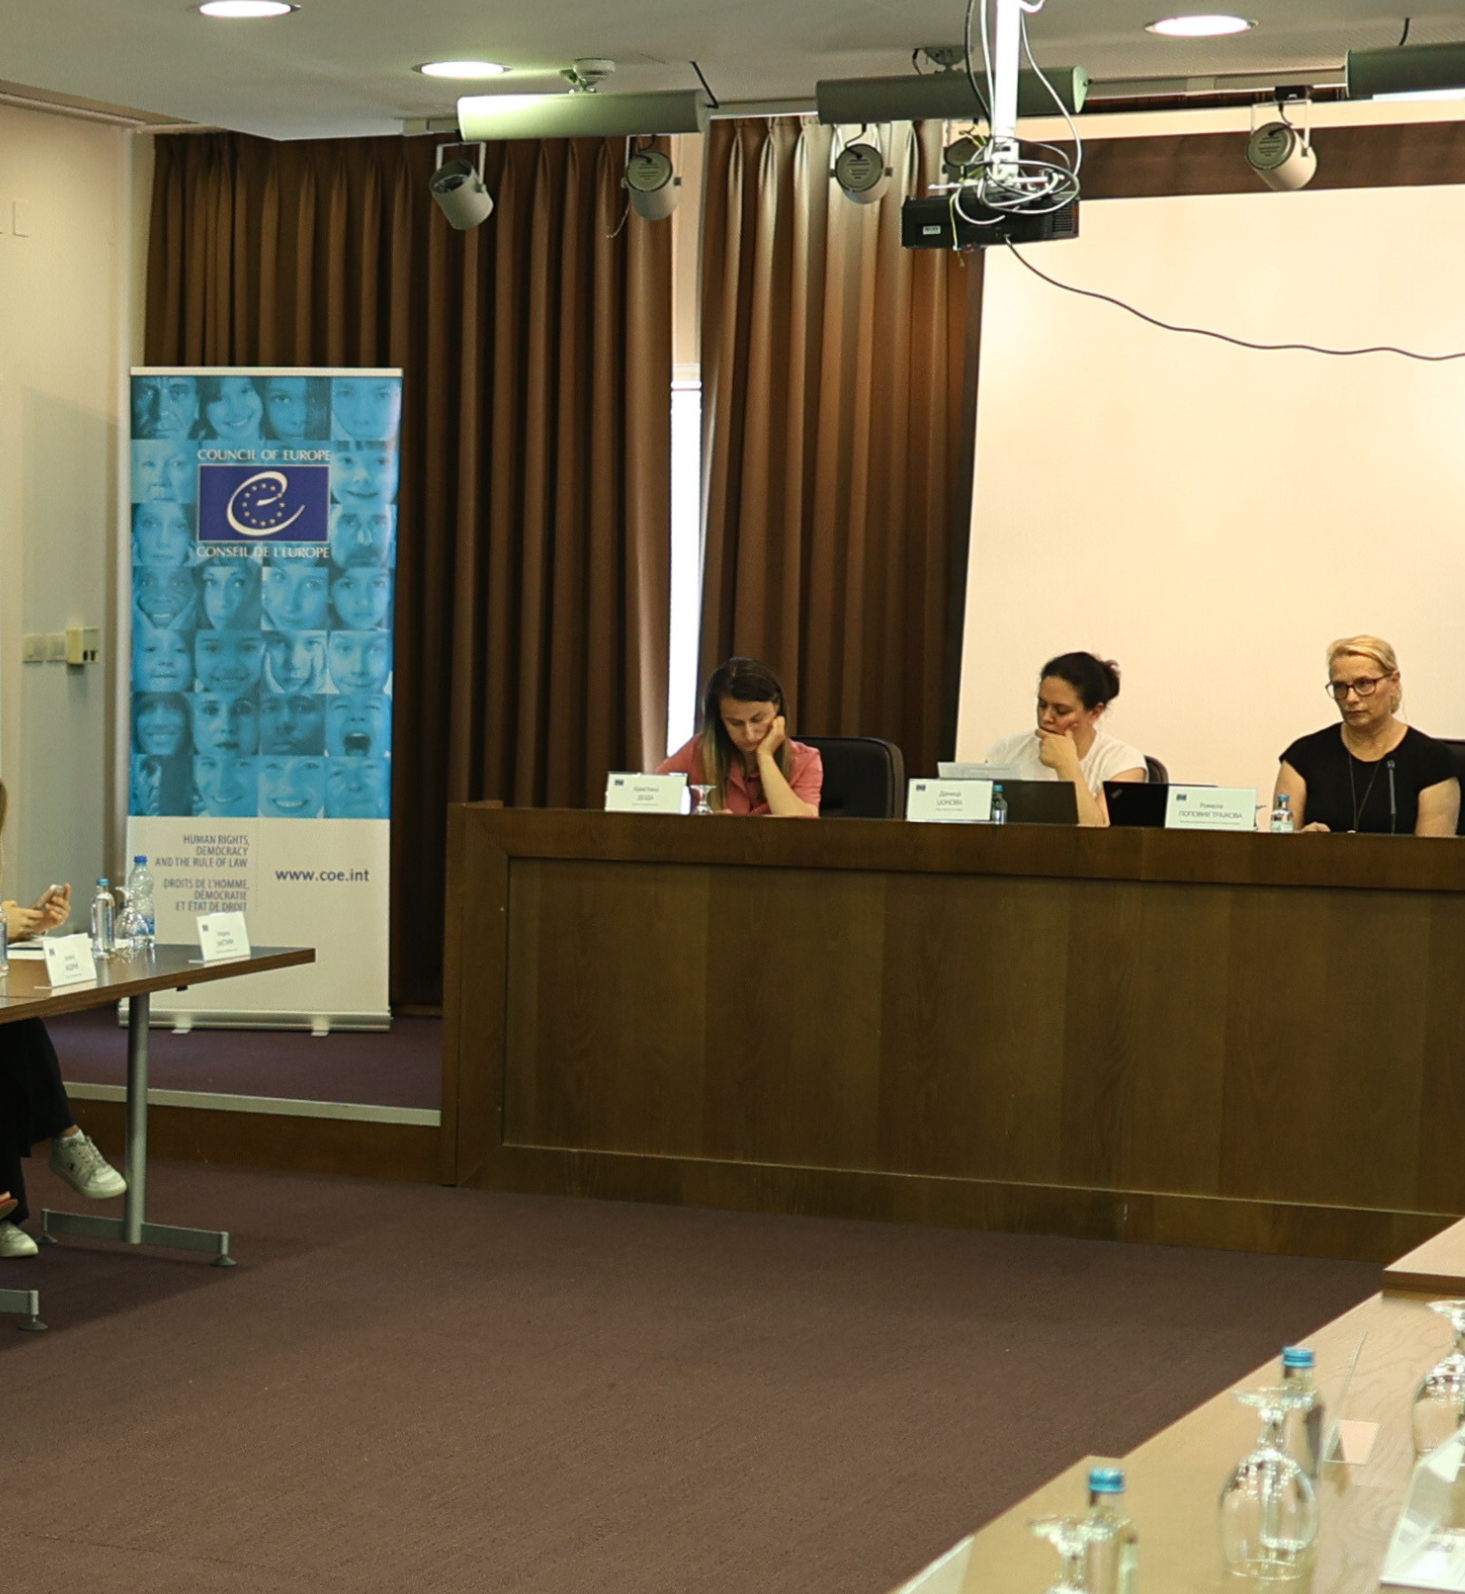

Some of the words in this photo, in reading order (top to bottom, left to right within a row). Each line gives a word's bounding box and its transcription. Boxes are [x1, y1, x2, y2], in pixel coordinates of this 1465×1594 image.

[197, 449, 256, 461] COUNCIL
[261, 449, 280, 461] OF
[283, 449, 332, 461] EUROPE
[196, 546, 248, 558] CONSEIL
[253, 546, 269, 558] DE
[274, 546, 330, 559] L'EUROPE
[183, 835, 216, 845] HUMAN
[218, 835, 250, 847] RIGHTS,
[196, 846, 248, 856] DEMOCRACY
[155, 857, 174, 868] AND
[175, 857, 190, 868] THE
[193, 857, 213, 868] RULE
[216, 858, 227, 868] OF
[229, 858, 247, 868] LAW
[275, 868, 370, 882] www.coe.int
[163, 878, 194, 889] DROITS
[195, 878, 206, 889] DE
[207, 878, 250, 890] L'HOMME,
[194, 889, 247, 900] DÉMOCRATIE
[175, 902, 185, 912] ET
[188, 900, 207, 912] ÉTAT
[209, 902, 219, 912] DE
[222, 902, 247, 913] DROIT
